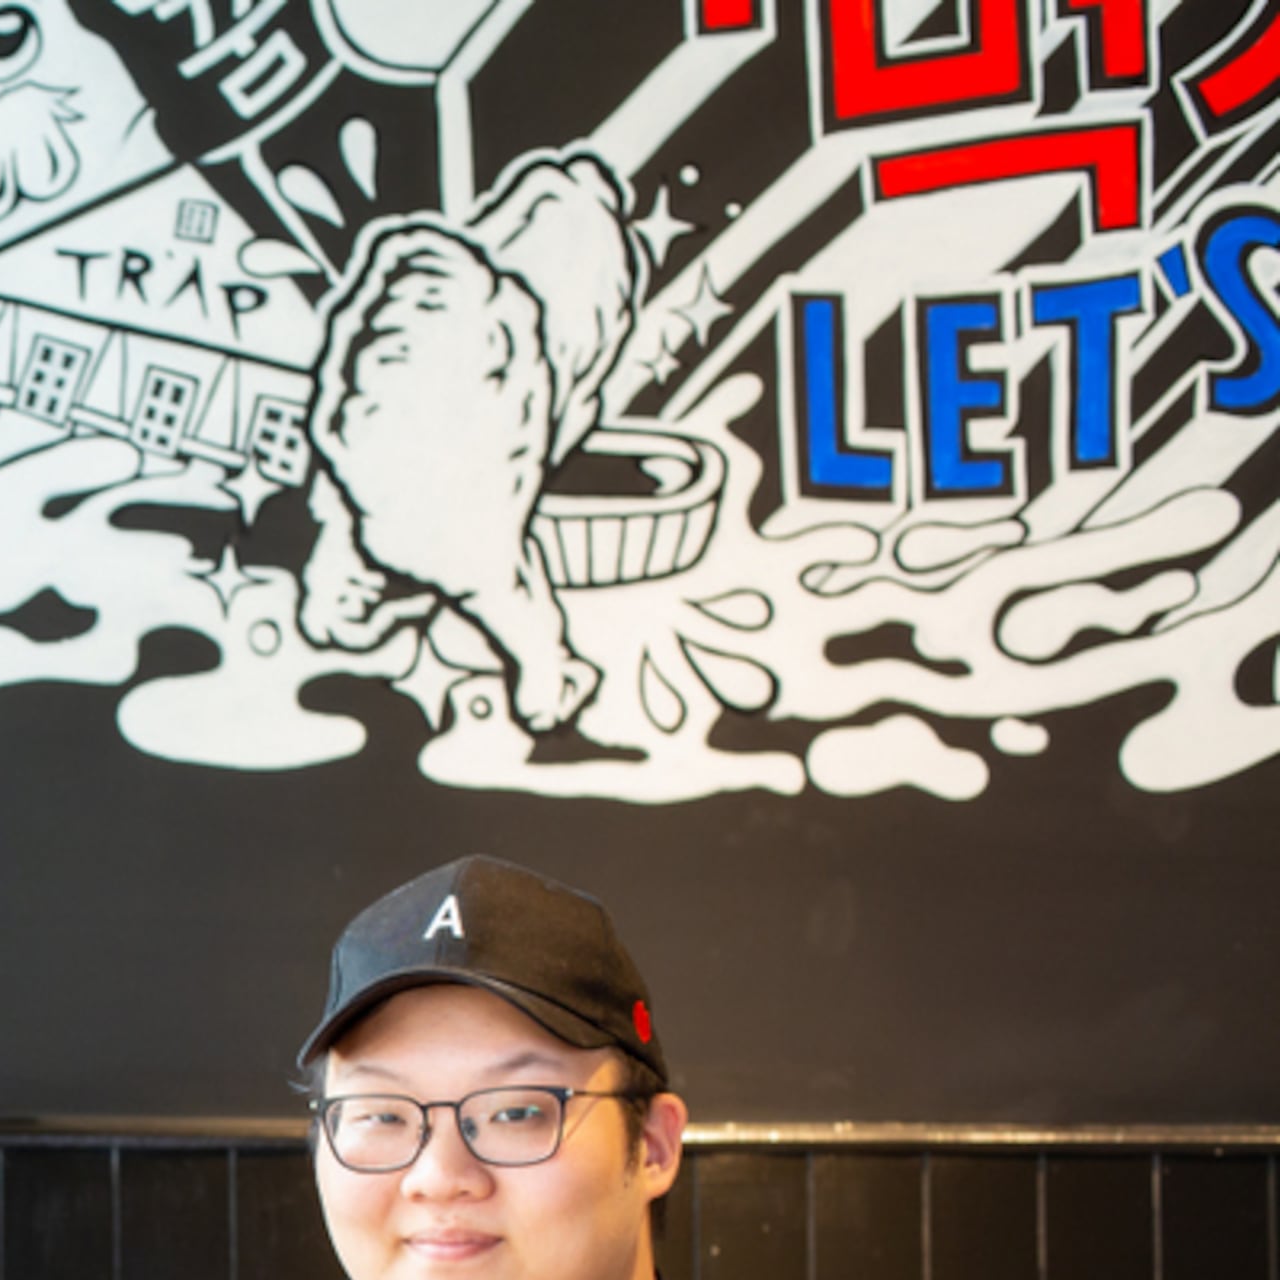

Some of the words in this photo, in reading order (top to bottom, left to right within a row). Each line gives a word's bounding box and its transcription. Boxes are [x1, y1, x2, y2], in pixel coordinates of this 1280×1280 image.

[54, 247, 269, 339] TRAP
[802, 215, 1280, 491] LET'S
[423, 894, 465, 940] A
